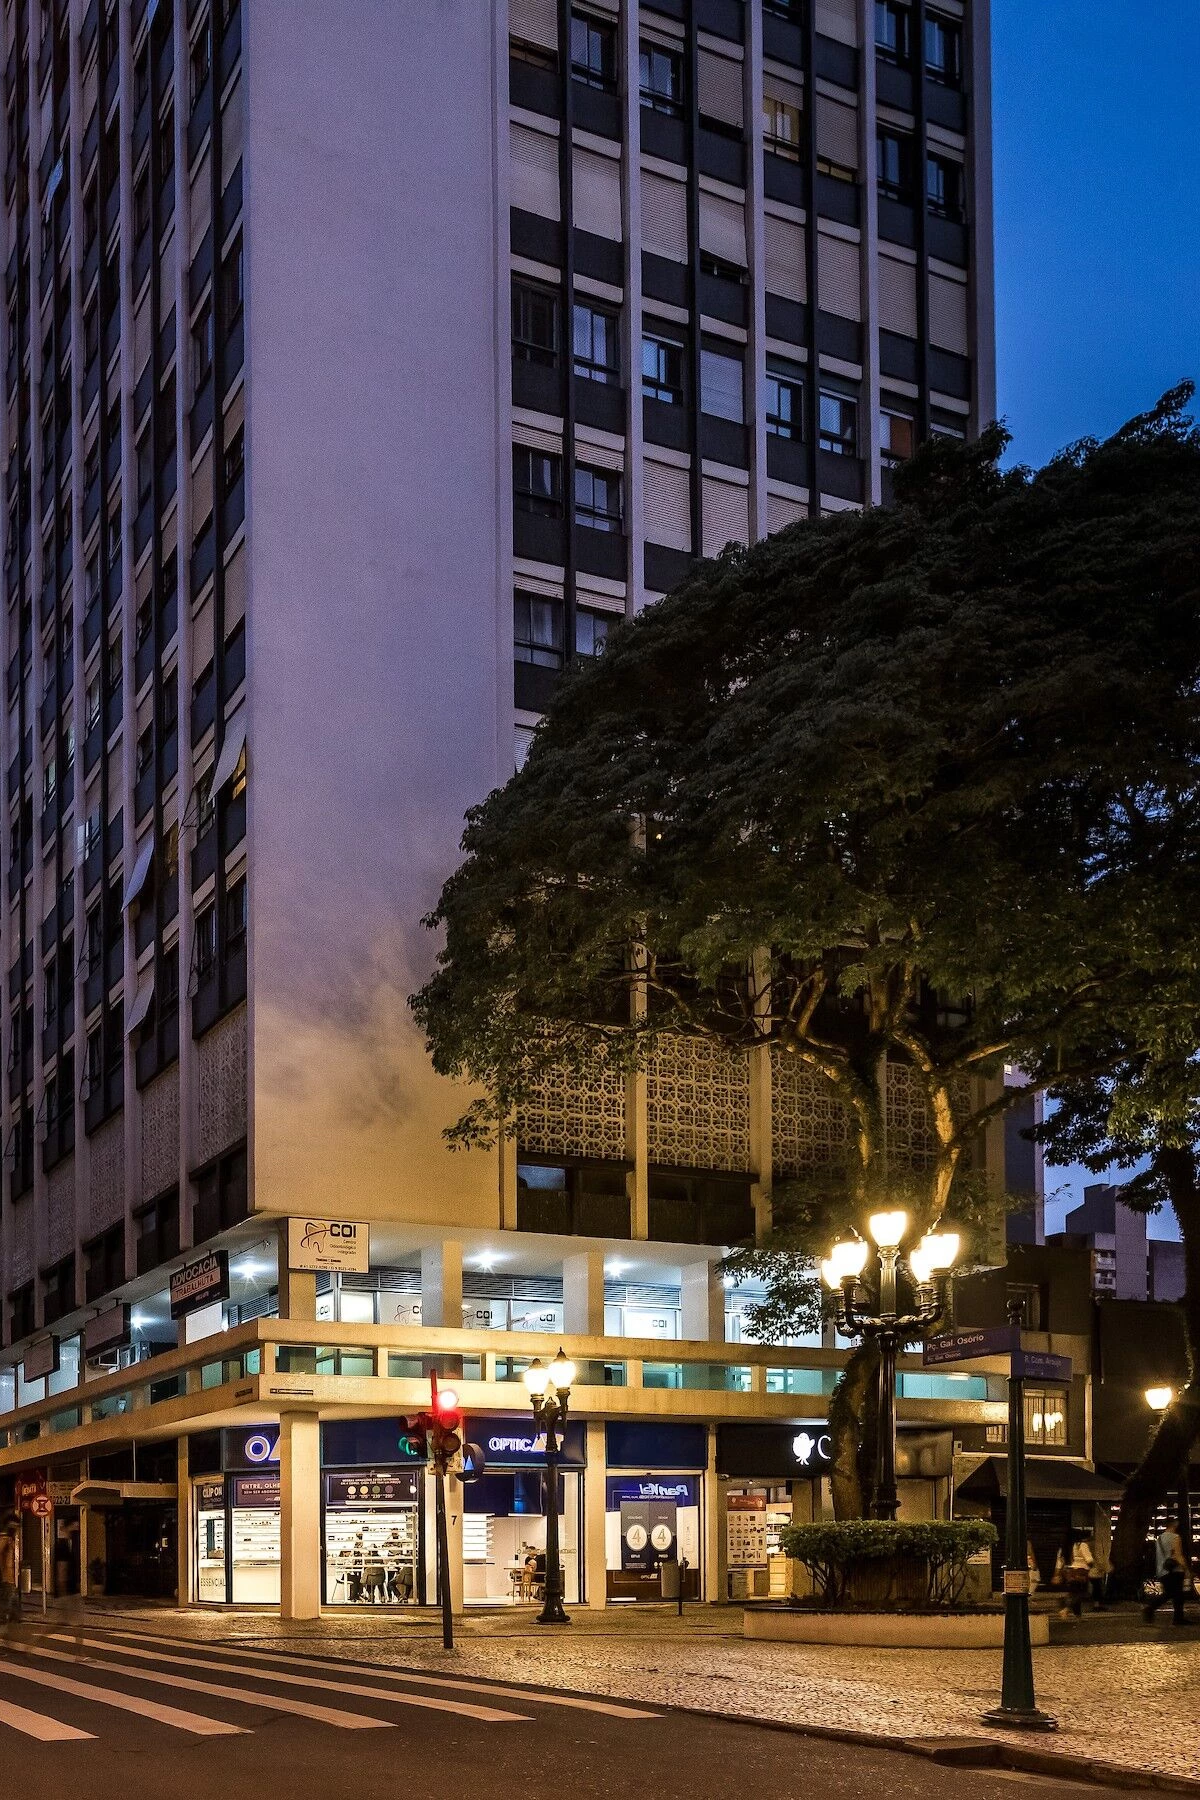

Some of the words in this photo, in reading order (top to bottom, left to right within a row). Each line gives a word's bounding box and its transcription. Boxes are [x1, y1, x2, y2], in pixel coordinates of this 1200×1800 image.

[330, 1224, 356, 1238] COI
[172, 1256, 218, 1288] ADVOCACIA
[476, 1310, 493, 1320] COI
[540, 1311, 556, 1321] COI
[652, 1319, 668, 1328] COI
[927, 1343, 939, 1351] Pç.
[940, 1340, 955, 1349] Gal.
[957, 1334, 984, 1345] Osório
[818, 1434, 831, 1460] C
[203, 1487, 214, 1499] CLIP
[451, 1515, 457, 1525] 7
[632, 1528, 641, 1543] 4
[657, 1528, 666, 1543] 4
[200, 1578, 226, 1587] ESSENCIAL
